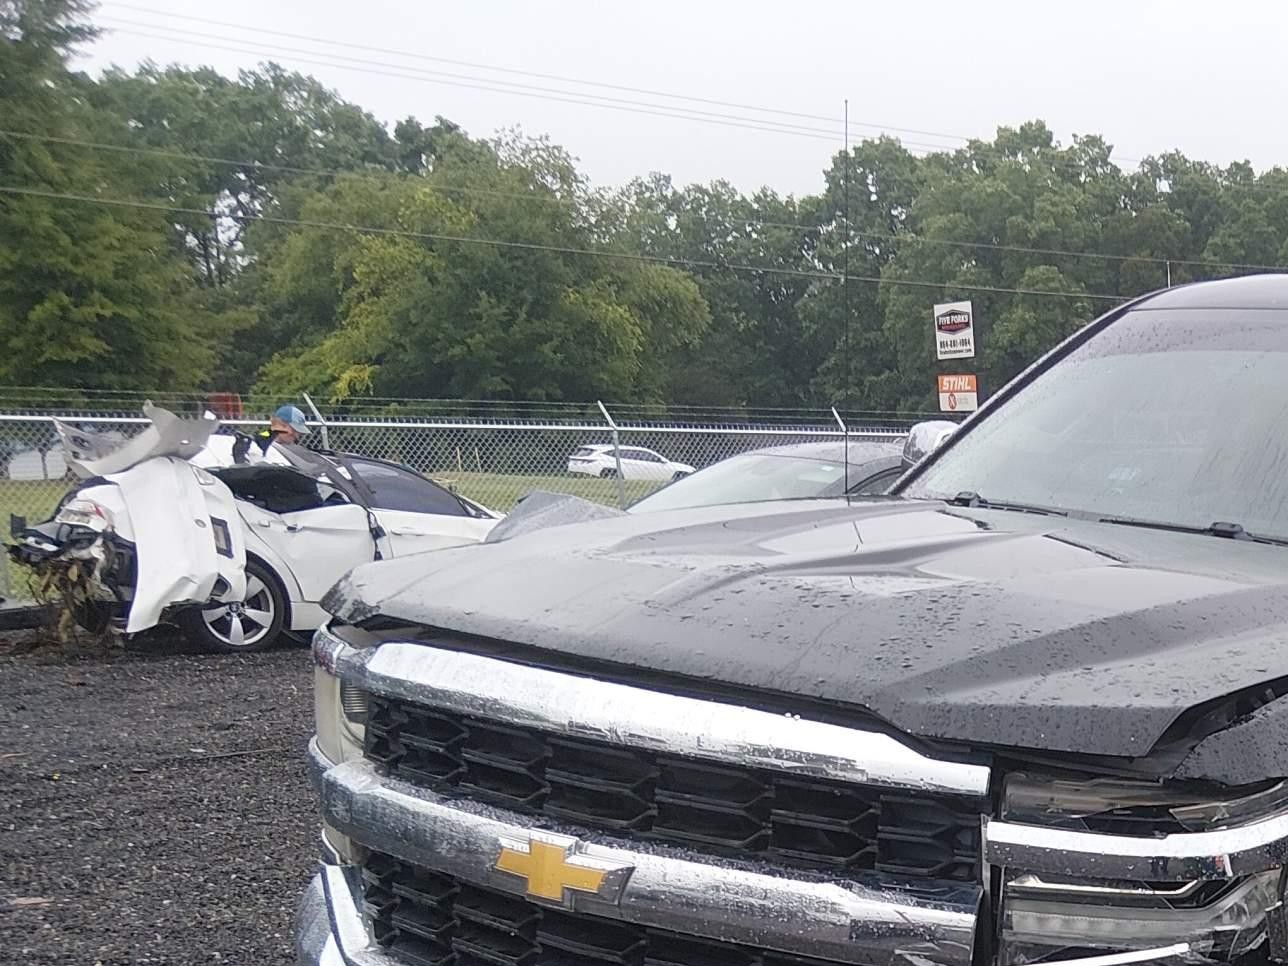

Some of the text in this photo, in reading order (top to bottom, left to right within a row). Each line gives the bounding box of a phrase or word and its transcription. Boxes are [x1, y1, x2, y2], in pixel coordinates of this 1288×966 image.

[939, 314, 969, 325] FIVE FORKS
[942, 377, 971, 390] STIHL
